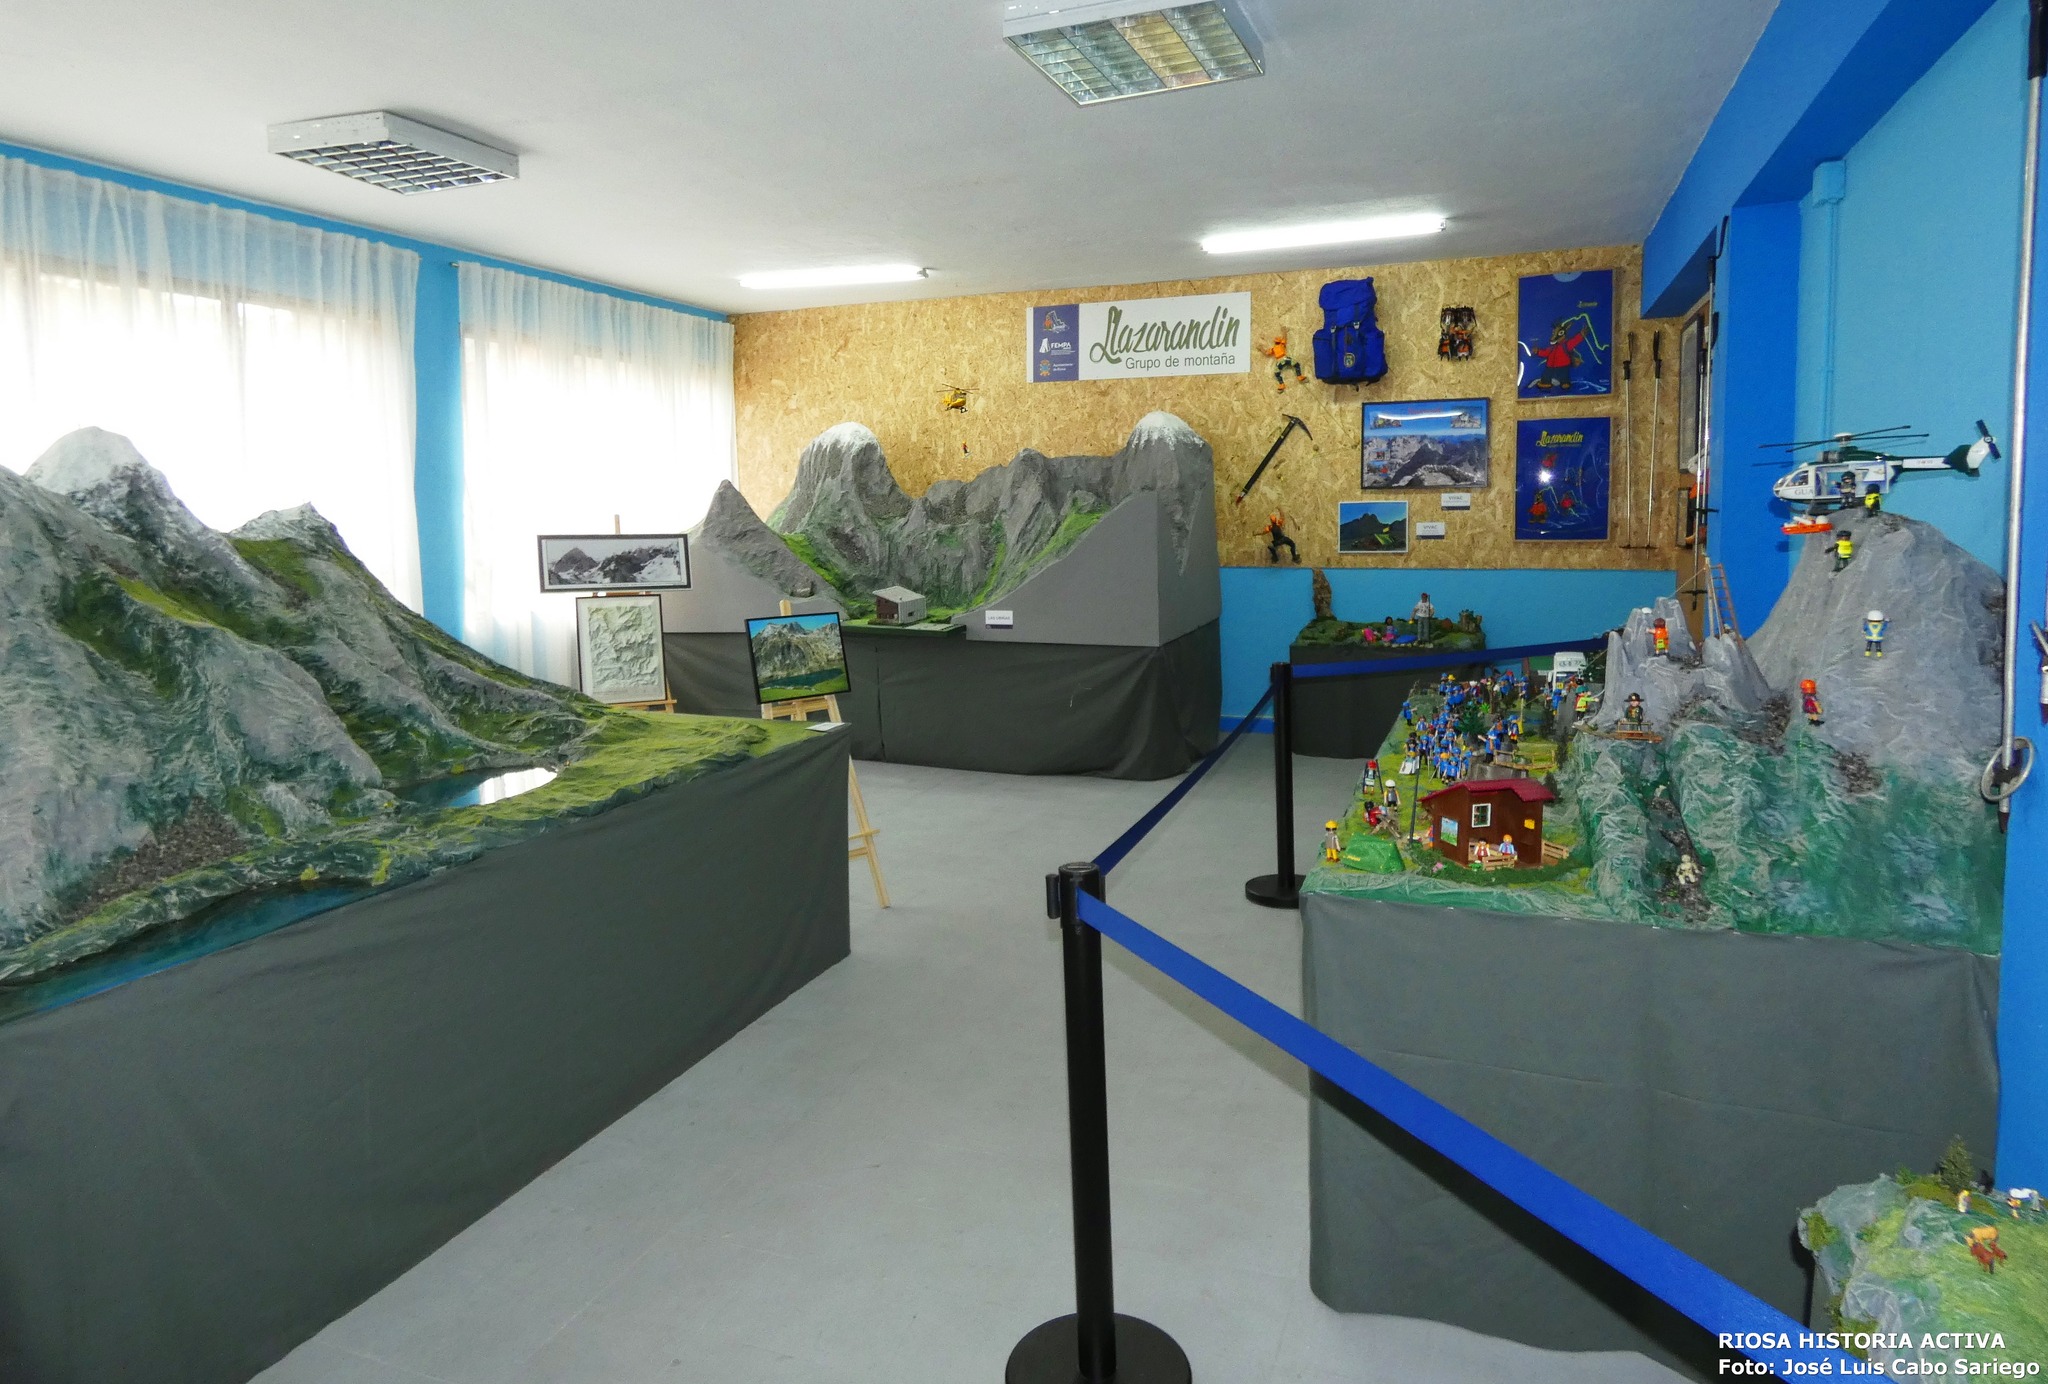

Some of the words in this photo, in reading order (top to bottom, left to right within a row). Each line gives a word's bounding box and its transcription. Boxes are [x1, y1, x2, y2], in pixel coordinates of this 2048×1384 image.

[1125, 356, 1161, 372] Grupo
[1165, 355, 1180, 368] de
[1184, 352, 1236, 367] montaña
